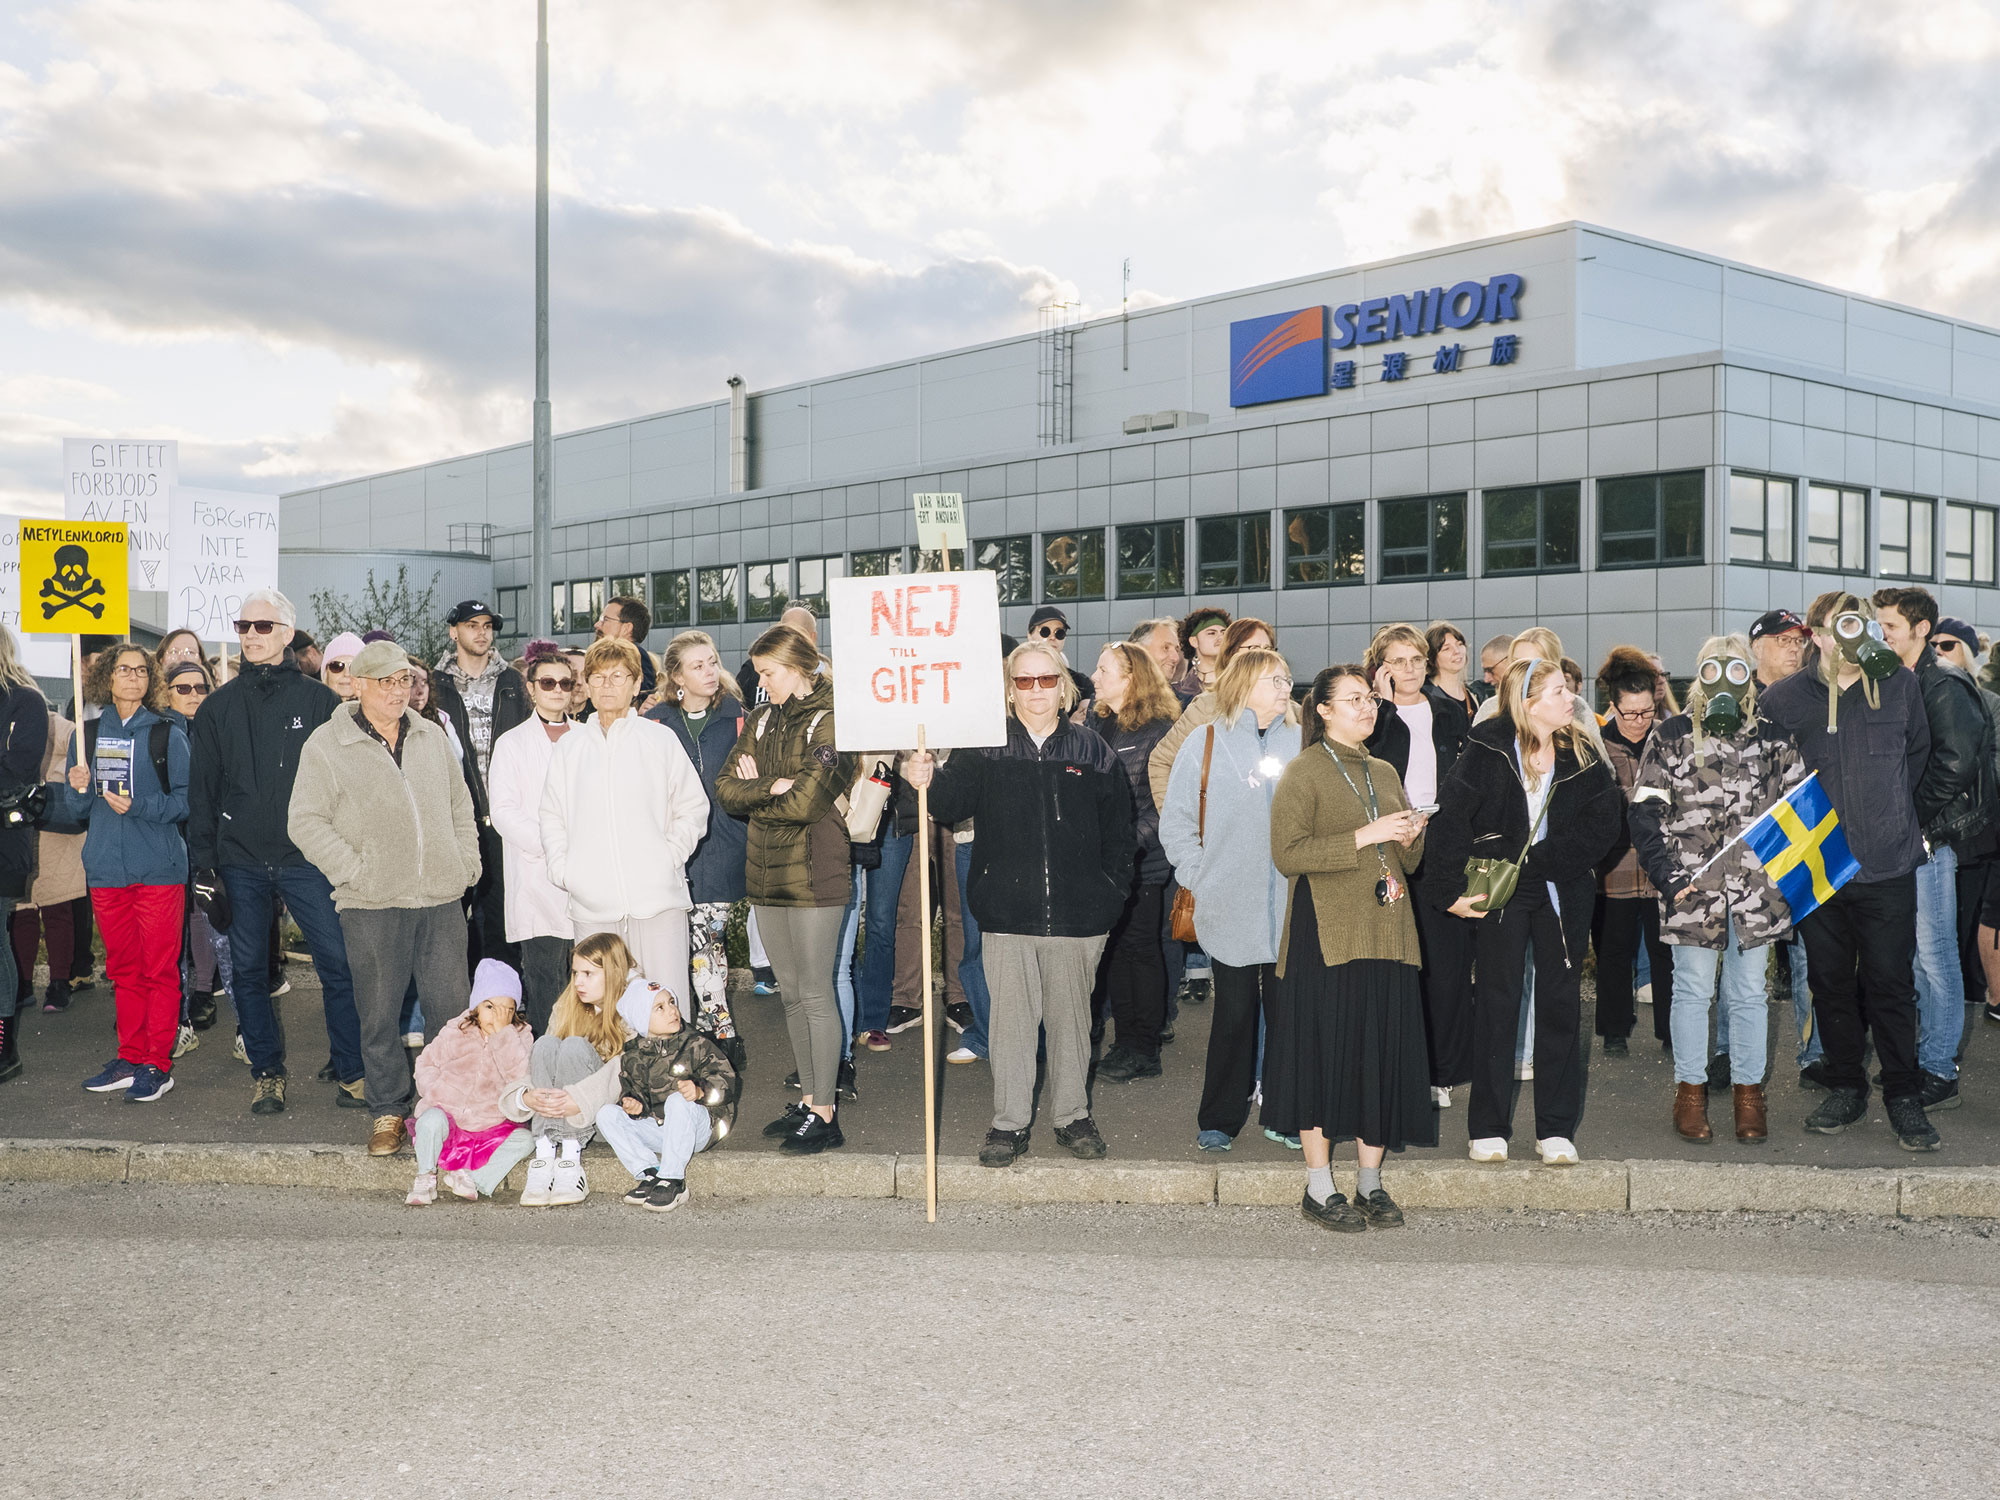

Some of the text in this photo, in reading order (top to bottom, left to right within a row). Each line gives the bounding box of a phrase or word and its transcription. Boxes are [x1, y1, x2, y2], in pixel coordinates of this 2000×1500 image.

[1330, 273, 1522, 349] SENIOR
[1331, 334, 1518, 389] 星源材质
[92, 444, 167, 468] GIFTET
[81, 499, 148, 523] AV EN
[194, 501, 277, 531] FÖRGIFTA
[23, 527, 124, 543] METYLENKLORID
[201, 534, 248, 558] INTE
[194, 562, 244, 585] VÅRA
[180, 586, 242, 636] BAR
[870, 584, 961, 637] NEJ
[890, 647, 917, 657] TILL
[871, 661, 961, 704] GIFT
